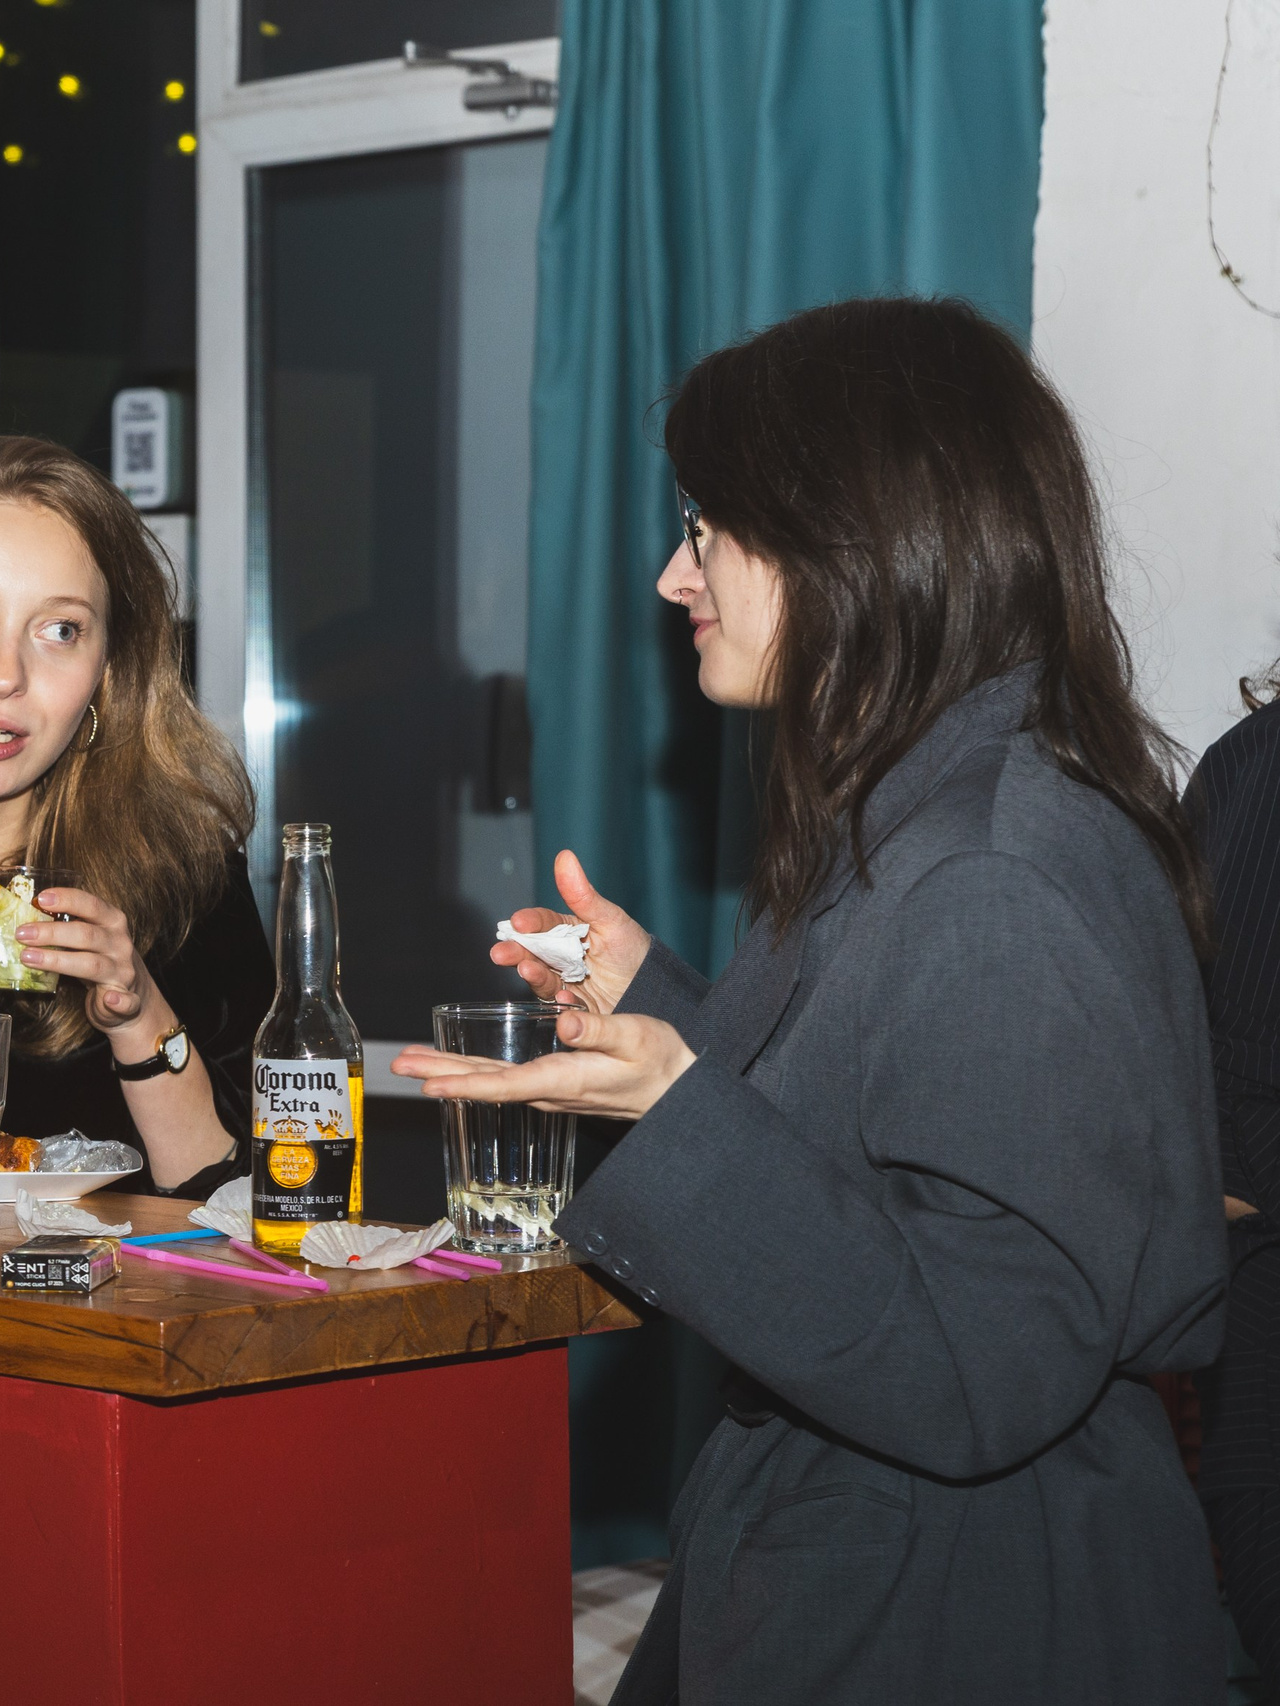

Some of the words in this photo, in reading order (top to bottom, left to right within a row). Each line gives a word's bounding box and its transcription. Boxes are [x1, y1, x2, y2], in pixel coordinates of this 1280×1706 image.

[254, 1063, 338, 1098] Corona
[269, 1092, 320, 1113] Extra
[271, 1156, 310, 1164] CERVEZA
[280, 1172, 300, 1180] FINA
[280, 1203, 303, 1212] MEXICO
[3, 1262, 46, 1273] KENT
